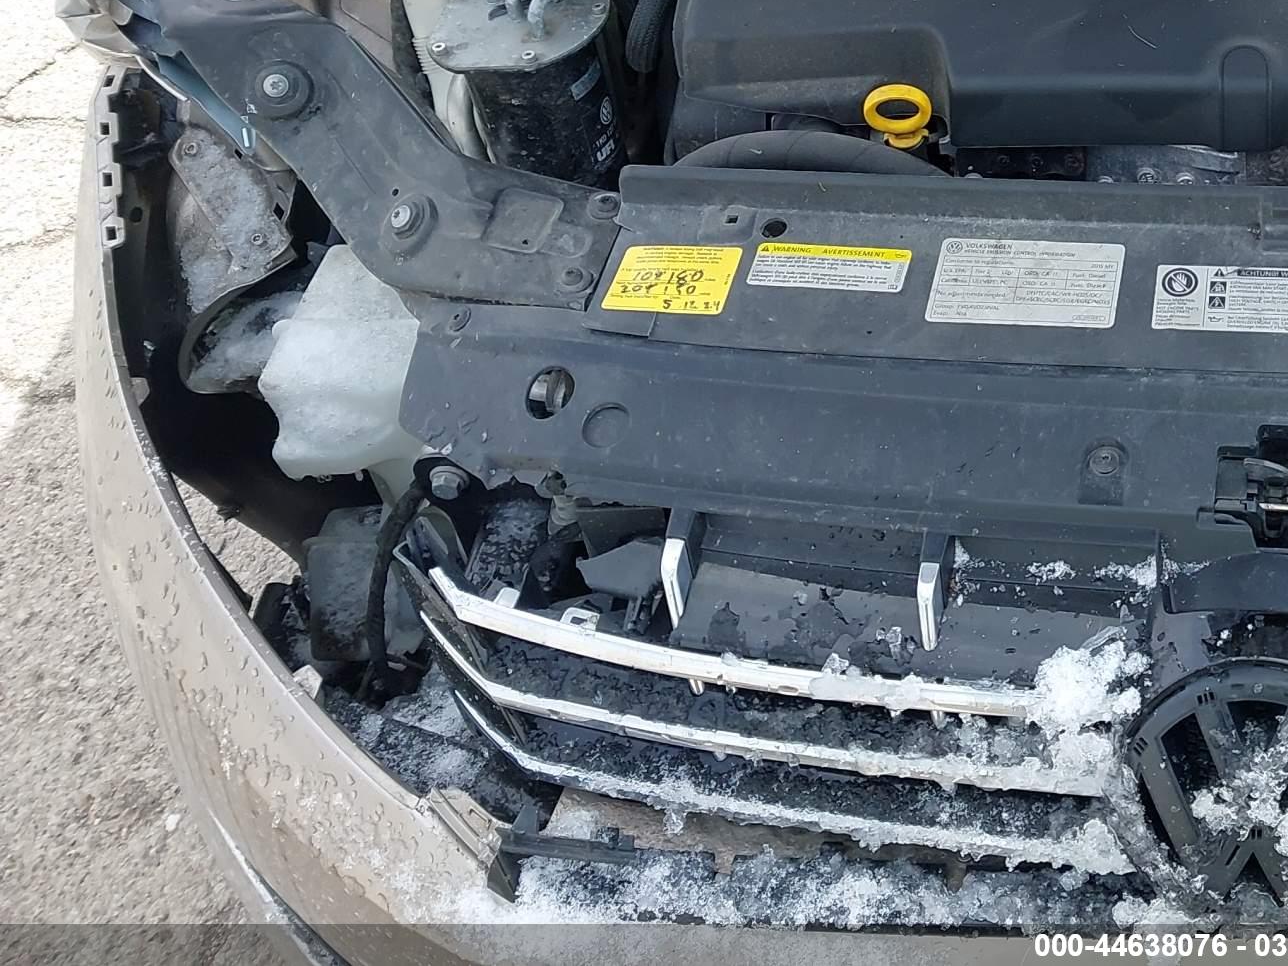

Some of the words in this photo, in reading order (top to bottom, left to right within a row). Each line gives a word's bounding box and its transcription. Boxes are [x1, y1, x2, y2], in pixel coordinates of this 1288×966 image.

[966, 242, 1013, 250] VOLKSWAGEN
[822, 247, 886, 257] AVERTISSEMENT
[1240, 270, 1279, 278] ACHTUNG!
